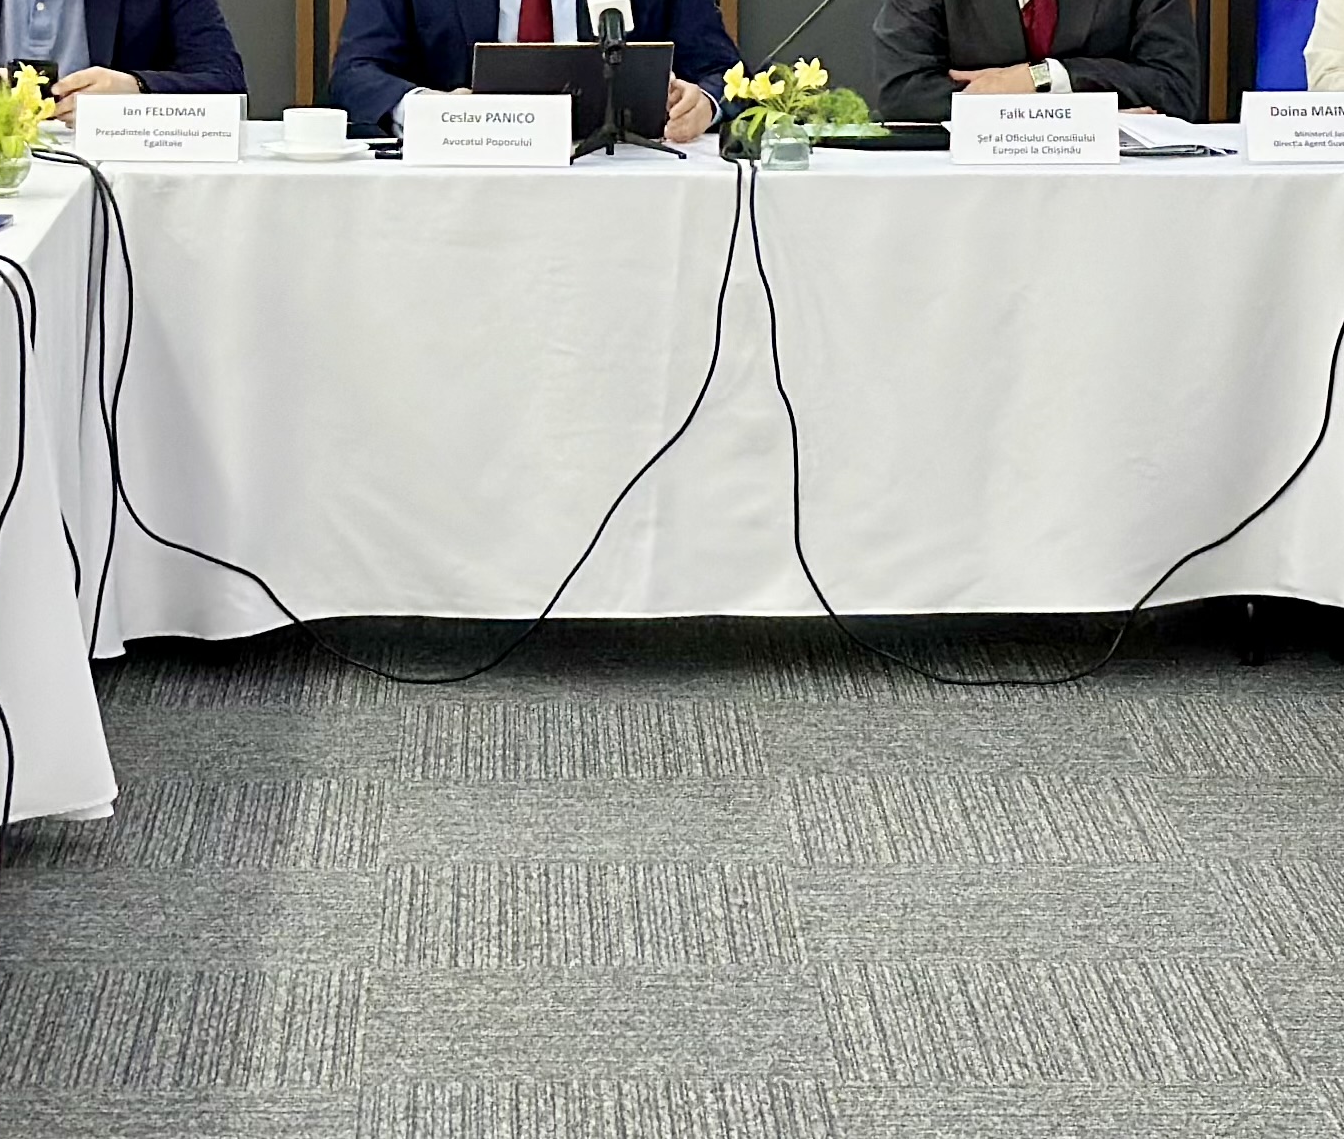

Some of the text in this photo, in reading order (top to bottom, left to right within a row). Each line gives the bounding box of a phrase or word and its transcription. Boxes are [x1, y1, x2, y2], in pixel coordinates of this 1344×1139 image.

[122, 106, 206, 117] Ian FELDMAN
[999, 108, 1072, 120] Falk LANGE
[1270, 106, 1308, 117] Doina
[441, 111, 535, 124] Ceslav PANICO
[201, 129, 232, 138] pentru
[994, 133, 1003, 143] al
[1005, 133, 1045, 143] Oficiului
[1046, 133, 1096, 143] Consiliului
[442, 137, 533, 148] Avocatul Poporului
[1030, 145, 1039, 155] la
